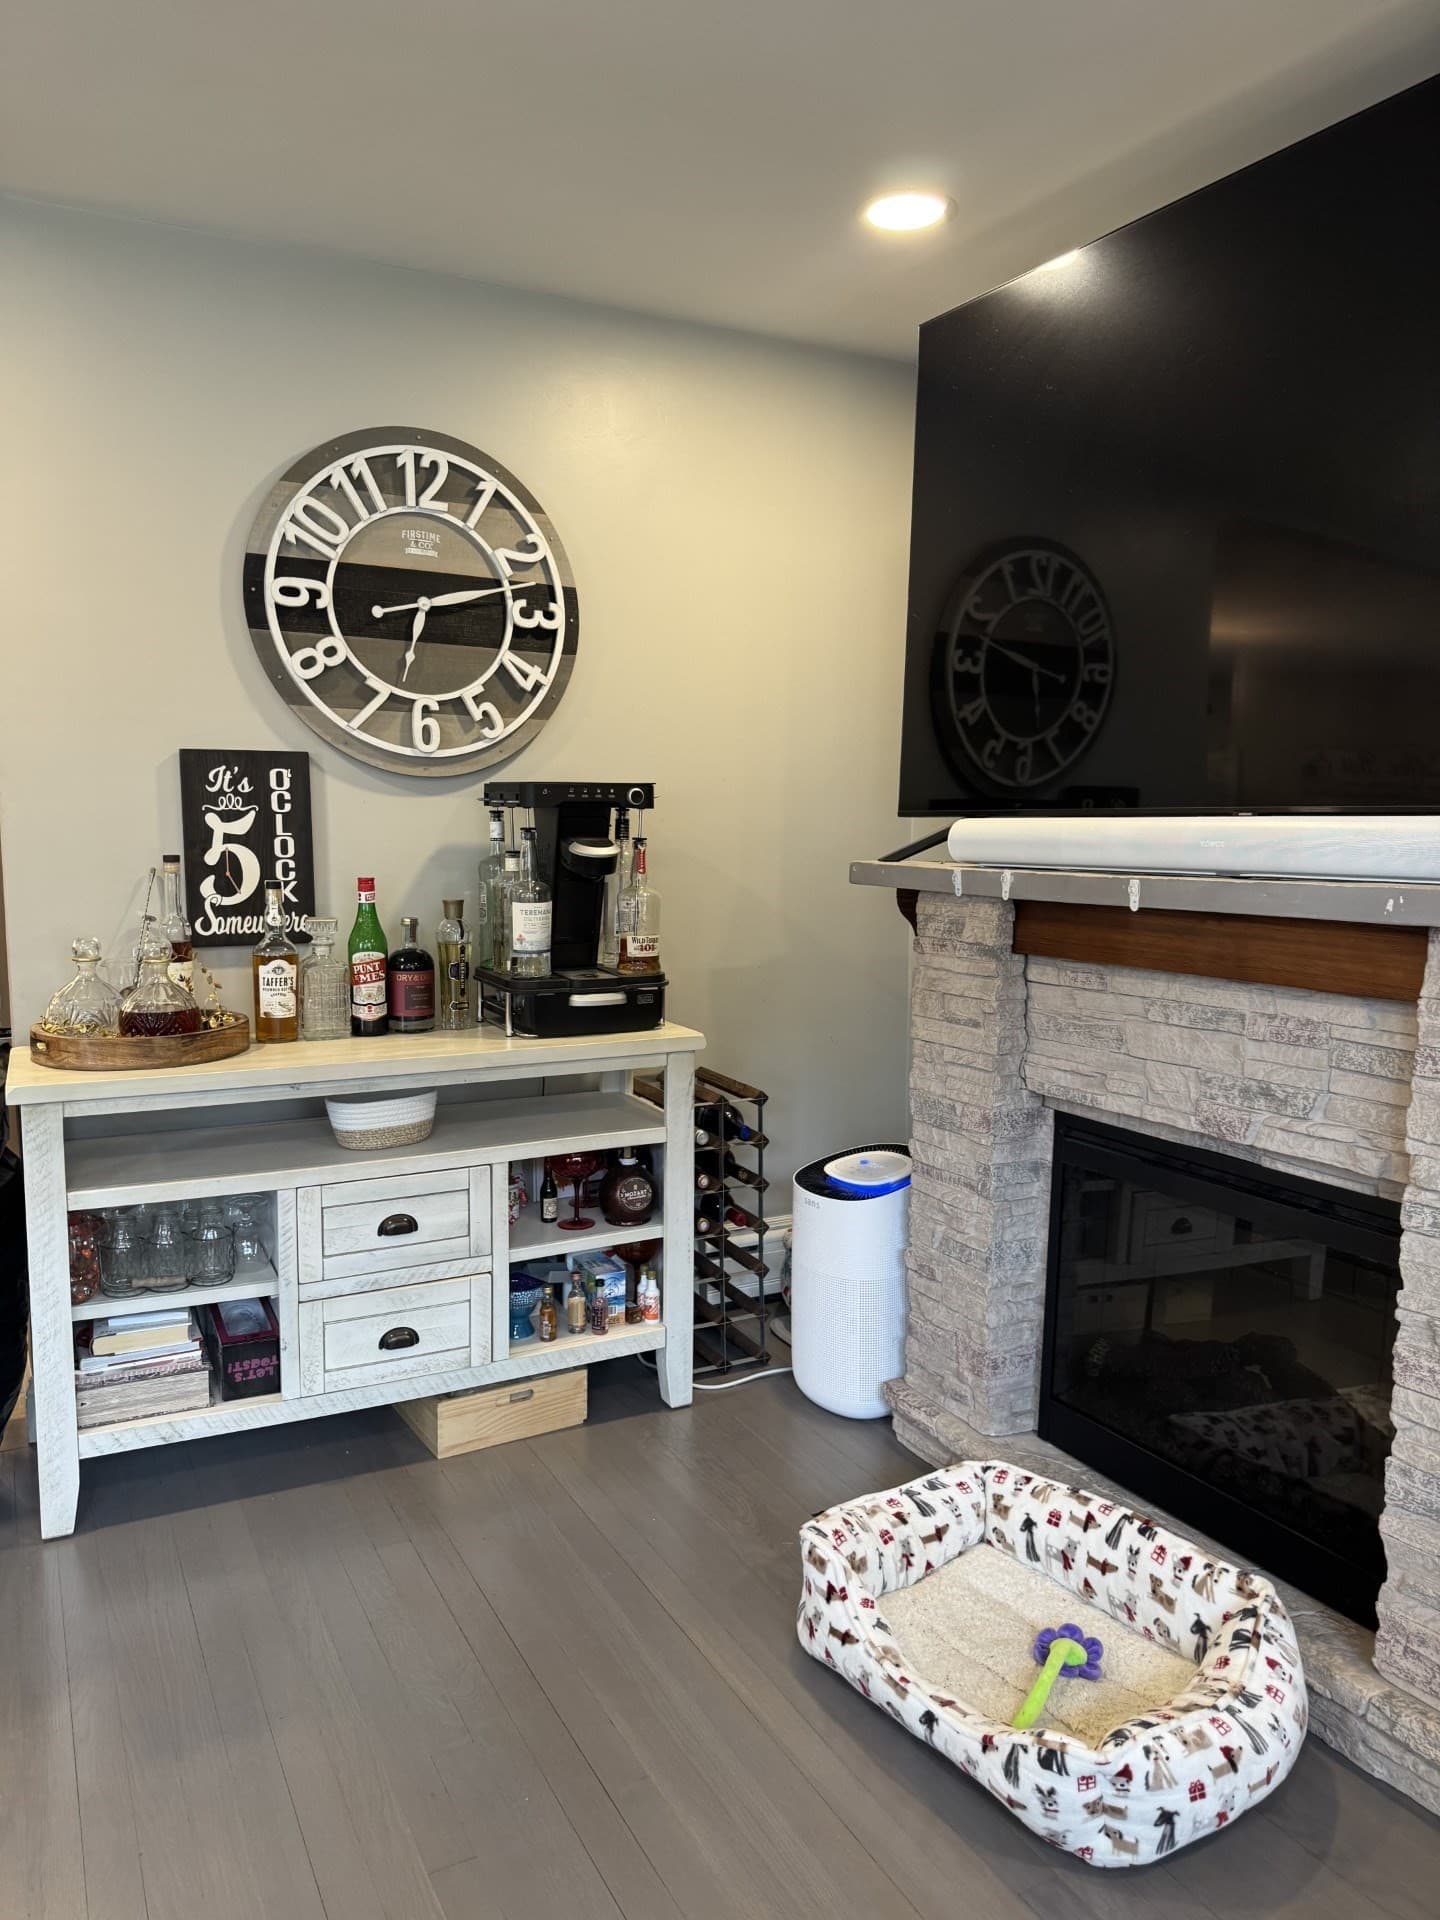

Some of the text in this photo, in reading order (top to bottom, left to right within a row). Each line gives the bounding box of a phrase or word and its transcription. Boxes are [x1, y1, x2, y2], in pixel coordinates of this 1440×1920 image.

[330, 456, 388, 521] 11
[397, 448, 450, 512] 12
[463, 480, 499, 531] 1
[285, 496, 350, 560] 10
[401, 529, 441, 544] FIRSTIME
[493, 534, 547, 577] 2
[271, 576, 329, 610] 9
[511, 599, 561, 630] 3
[290, 636, 347, 680] 8
[501, 650, 550, 692] 4
[347, 675, 392, 730] 7
[461, 684, 504, 739] 5
[411, 698, 441, 753] 6
[205, 765, 254, 793] It's
[268, 768, 299, 902] O'CLOCK
[199, 810, 260, 906] 5
[195, 893, 308, 936] Somewere
[353, 961, 381, 974] PUNT
[640, 944, 656, 952] 101
[262, 976, 294, 987] TAFFER'S
[359, 970, 386, 983] MES
[396, 974, 413, 982] DRY
[625, 1189, 648, 1197] MOZART
